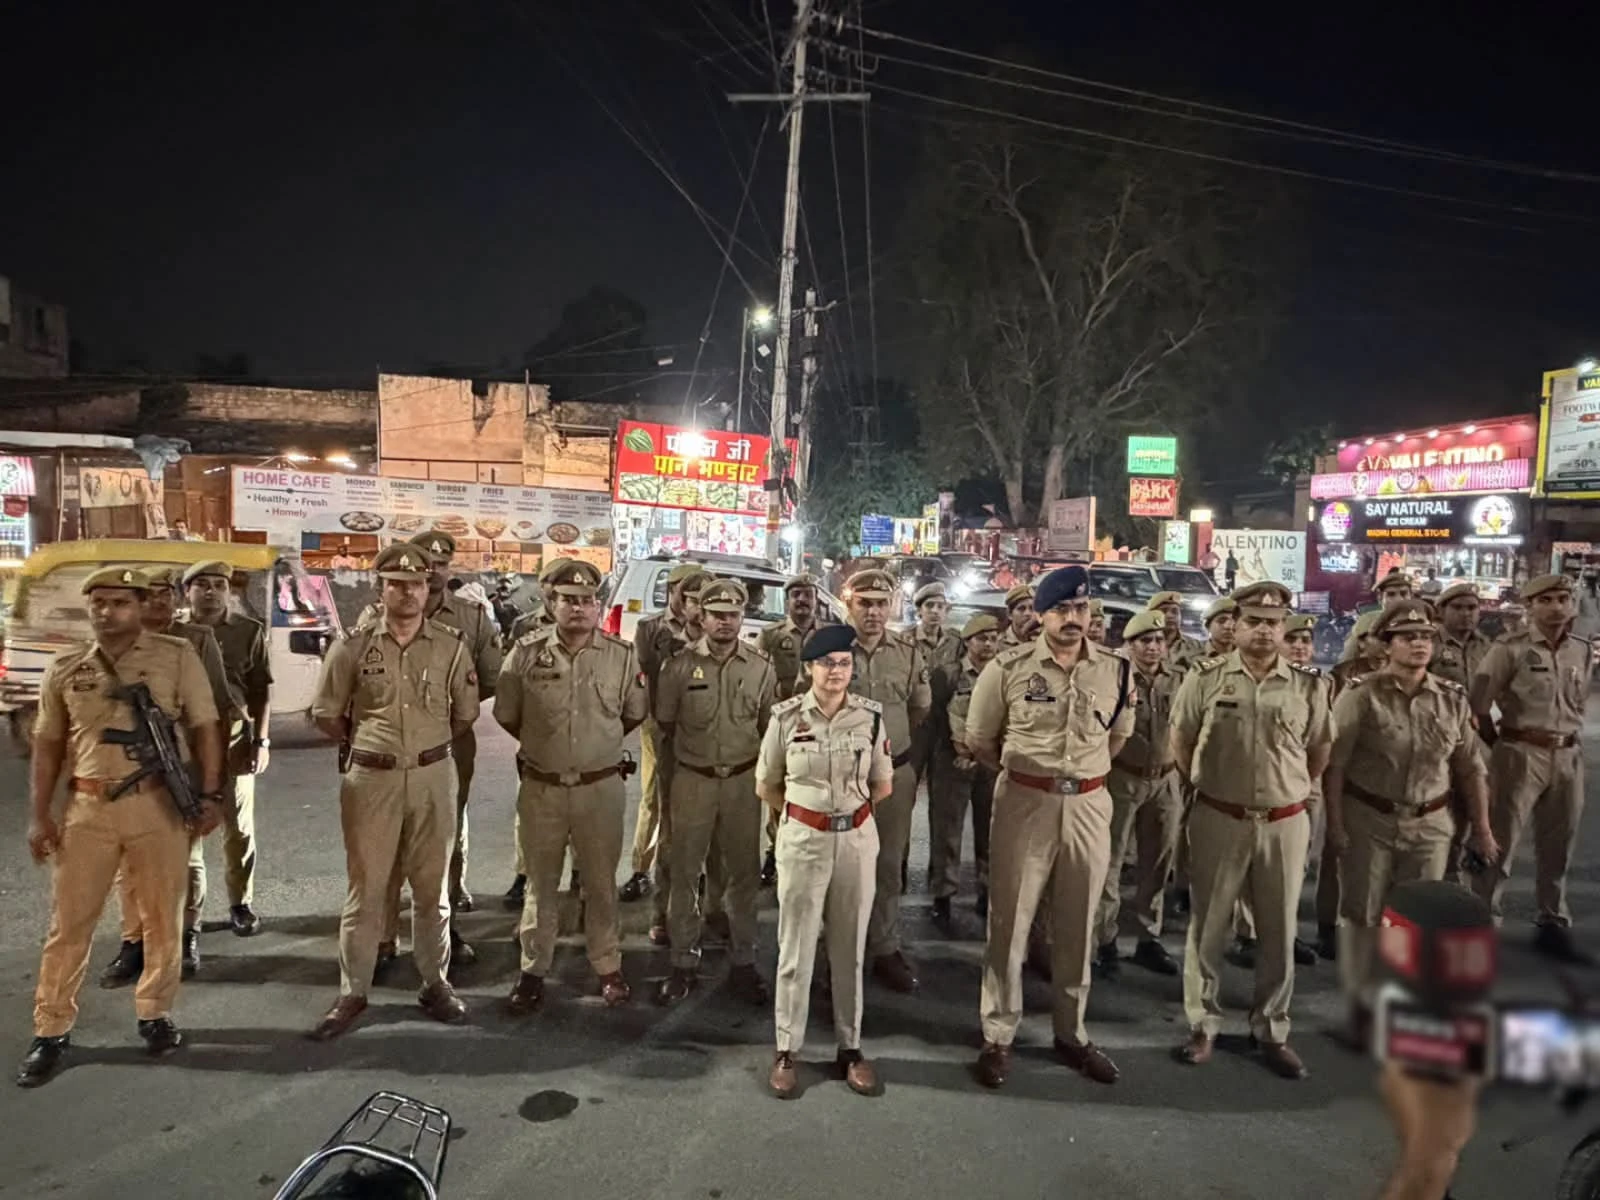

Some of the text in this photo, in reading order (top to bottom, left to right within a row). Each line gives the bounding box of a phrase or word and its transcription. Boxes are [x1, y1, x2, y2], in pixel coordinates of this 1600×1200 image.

[726, 439, 752, 461] जी
[653, 455, 760, 483] पान भण्डार
[243, 471, 331, 489] HOME CAFE
[482, 487, 504, 496] FRIES
[253, 493, 328, 507] Healthy Fresh
[272, 508, 307, 519] Homely
[1365, 501, 1453, 516] SAY NATURAL
[1386, 517, 1428, 526] ICE CREAM
[1424, 529, 1450, 537] STORE
[1213, 535, 1298, 550] ALENTINO
